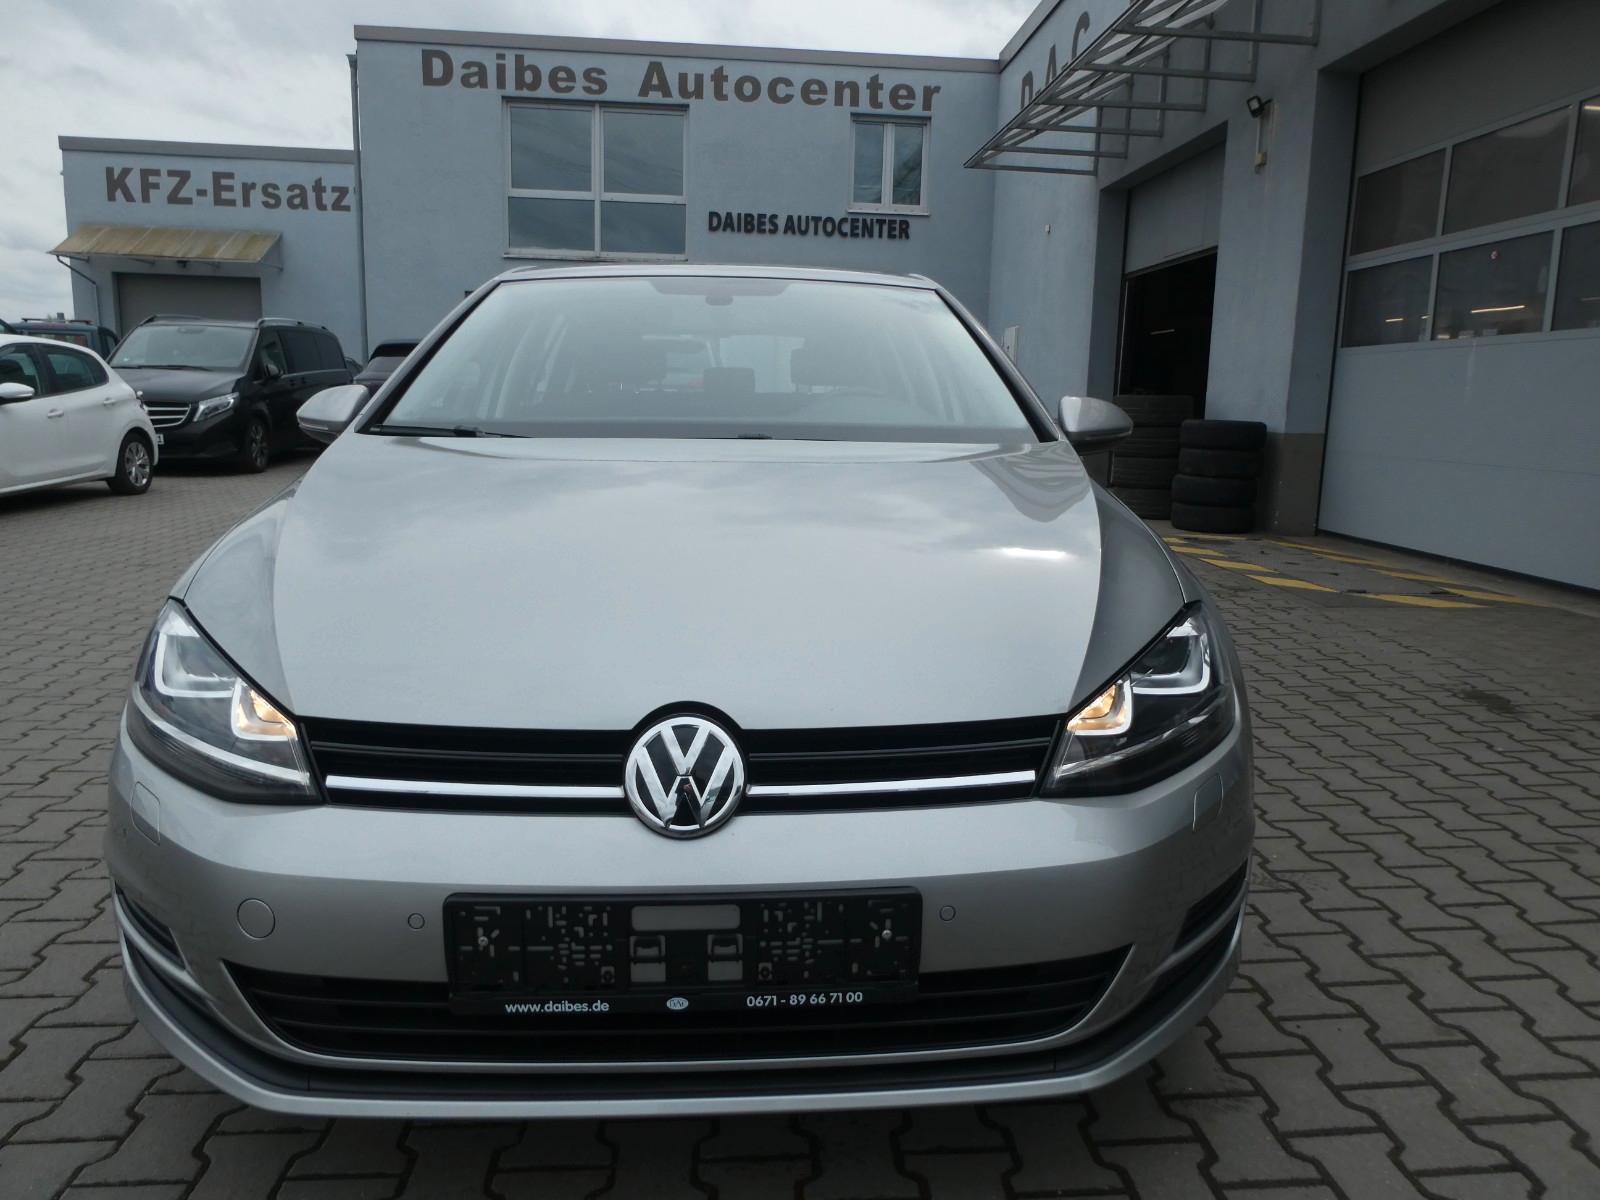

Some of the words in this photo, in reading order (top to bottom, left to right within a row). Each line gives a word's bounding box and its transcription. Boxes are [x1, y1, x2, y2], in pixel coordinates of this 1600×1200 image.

[422, 48, 608, 95] Daibes
[638, 61, 941, 111] Autocenter
[105, 166, 358, 212] KFZ-Ersatz
[708, 211, 779, 235] DAIBES
[783, 214, 910, 240] AUTOCENTER
[504, 999, 610, 1013] www.daibes.de
[746, 995, 777, 1007] 0671
[789, 994, 807, 1006] 89
[809, 993, 827, 1005] 66
[829, 992, 843, 1004] 71
[845, 991, 863, 1003] 00
